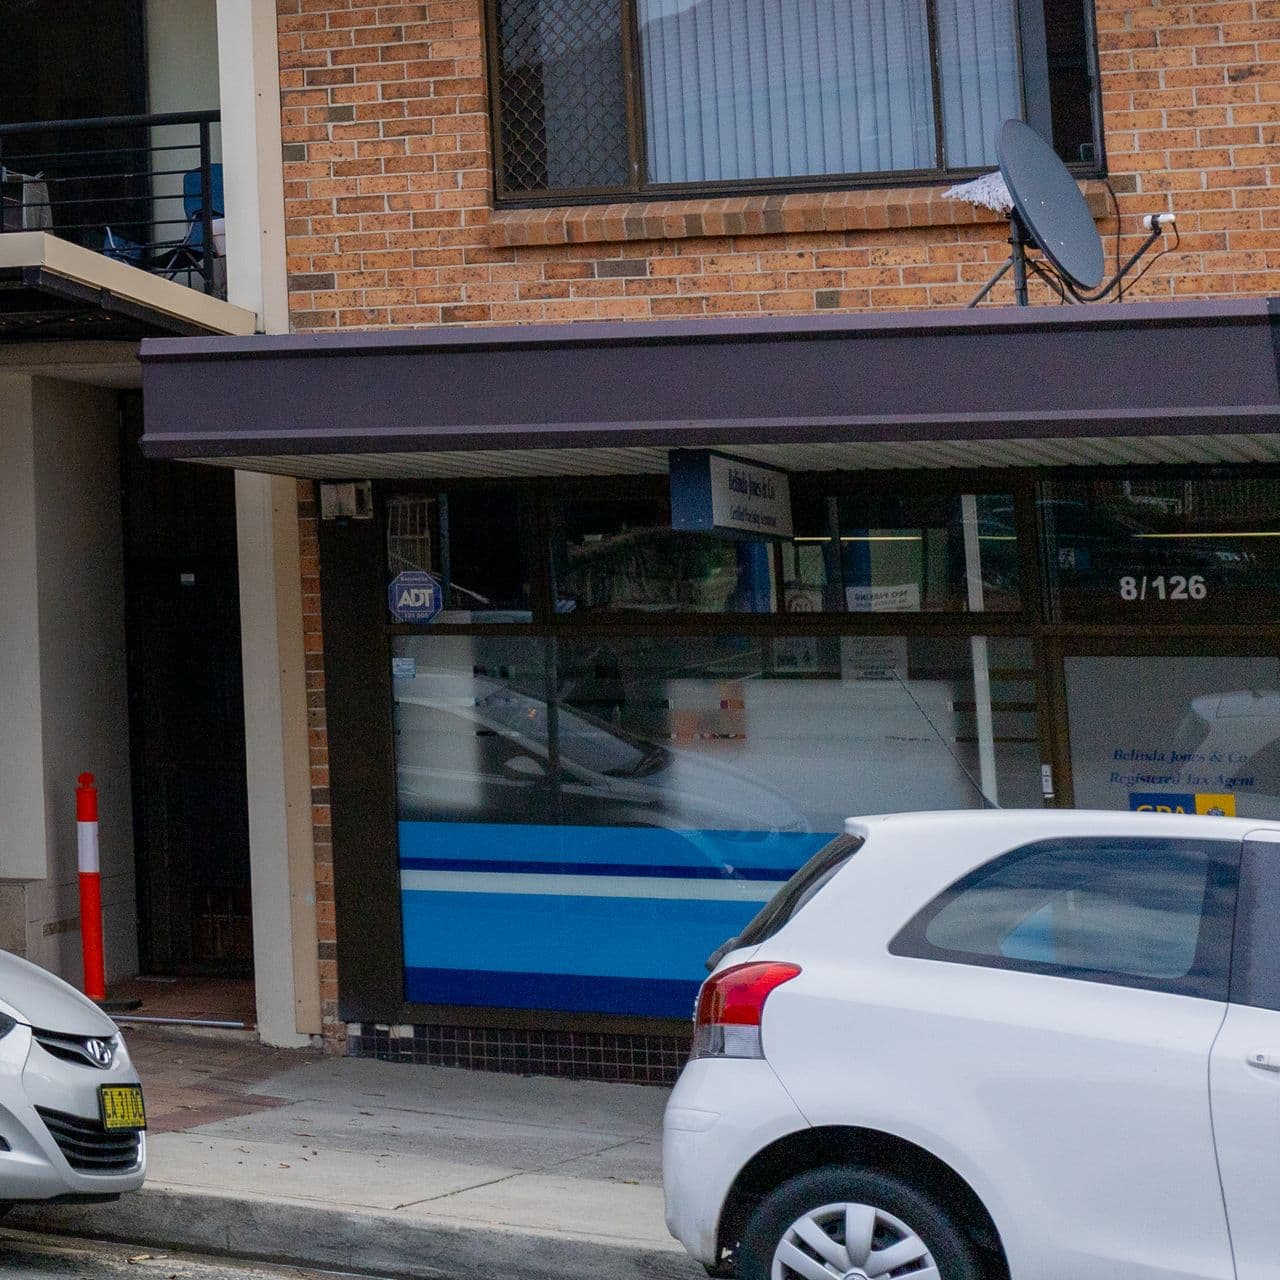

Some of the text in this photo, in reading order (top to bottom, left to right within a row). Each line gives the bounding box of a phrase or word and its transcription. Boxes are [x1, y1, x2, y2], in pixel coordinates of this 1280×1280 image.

[1119, 575, 1207, 601] 8/126
[398, 588, 434, 607] ADT
[1112, 749, 1165, 763] Belinda
[1169, 750, 1206, 764] Jones
[1209, 752, 1223, 763] &
[1110, 772, 1182, 787] Registered
